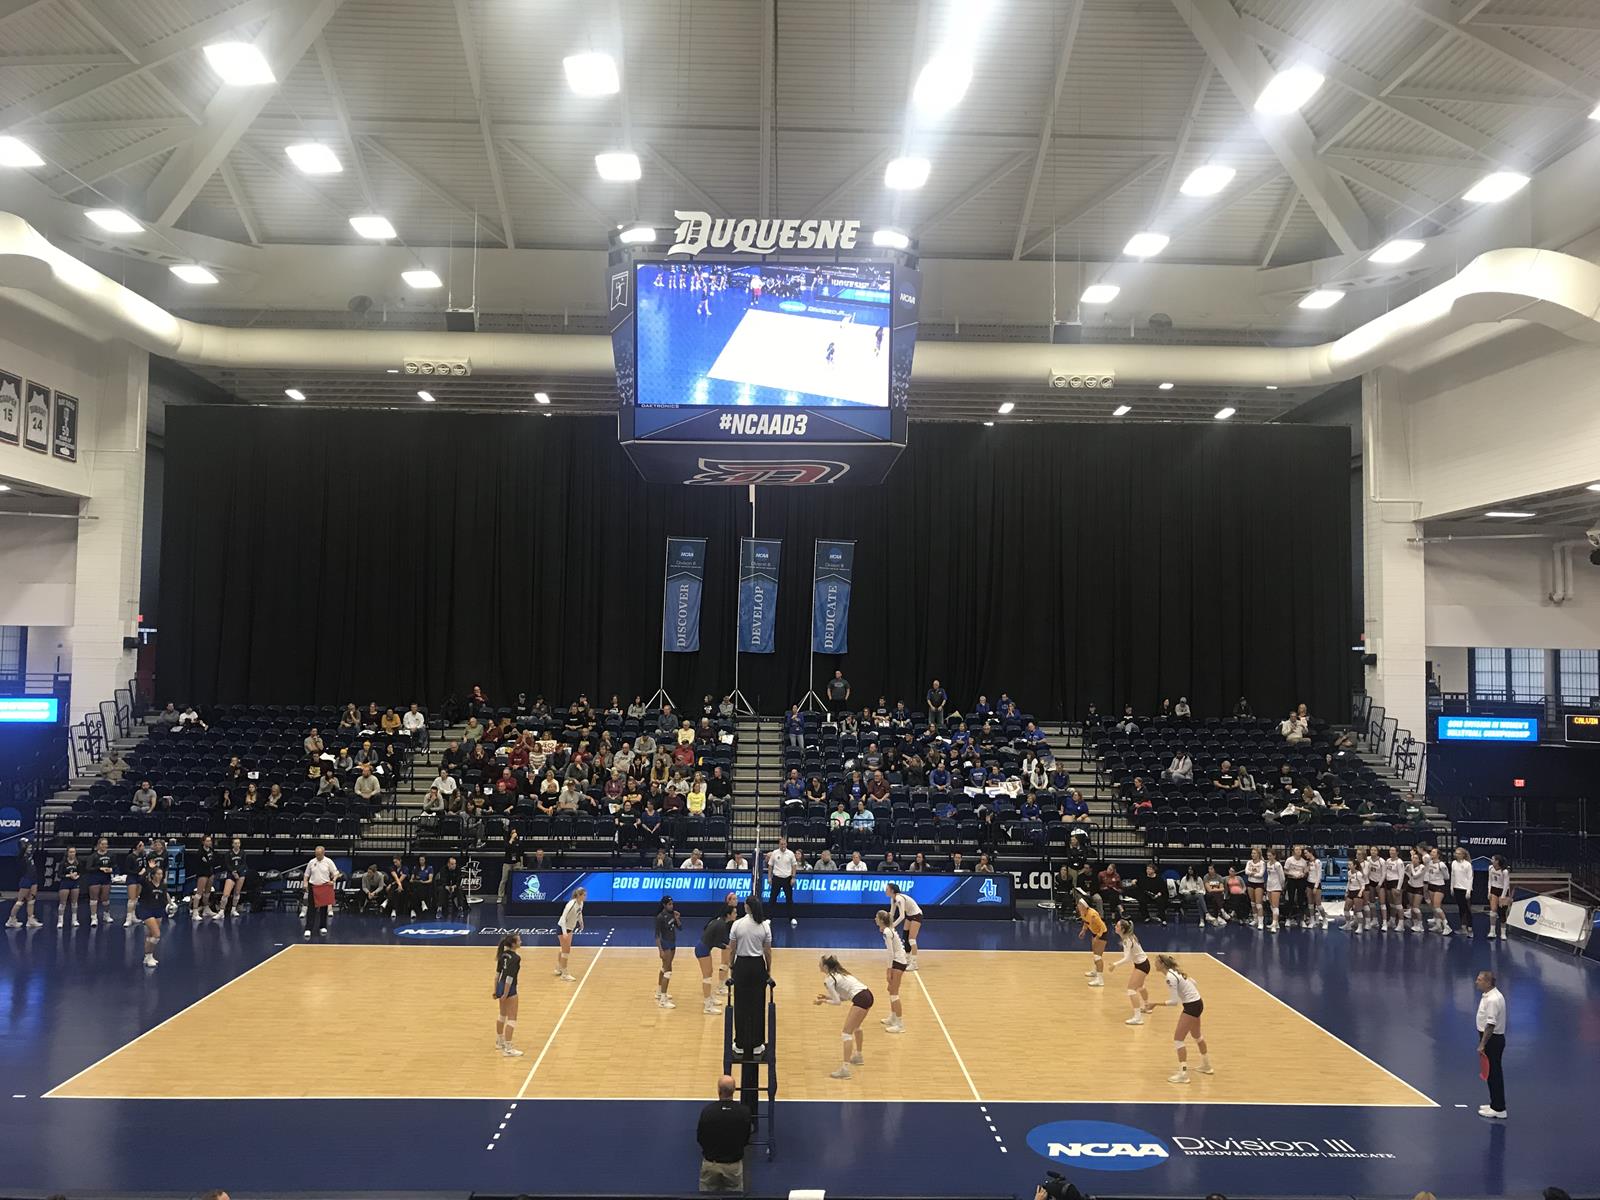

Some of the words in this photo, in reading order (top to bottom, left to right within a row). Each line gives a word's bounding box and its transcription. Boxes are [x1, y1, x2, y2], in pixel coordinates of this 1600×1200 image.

[667, 209, 861, 256] DUQUESNE
[3, 407, 13, 422] 15
[32, 417, 43, 432] 24
[719, 413, 808, 435] #NCAAD3
[677, 583, 690, 648] DISCOVER
[752, 586, 764, 645] DEVELOP
[824, 585, 838, 649] DEDICATE
[1469, 837, 1507, 845] VOLLEYBALL
[612, 877, 639, 889] 2018
[642, 877, 691, 889] DIVISION
[694, 877, 706, 889] III
[710, 877, 751, 890] WOMEN
[829, 879, 915, 893] CHAMPIONHIP
[1047, 1142, 1169, 1158] NCAA
[1172, 1136, 1319, 1152] Division
[1323, 1138, 1356, 1152] III
